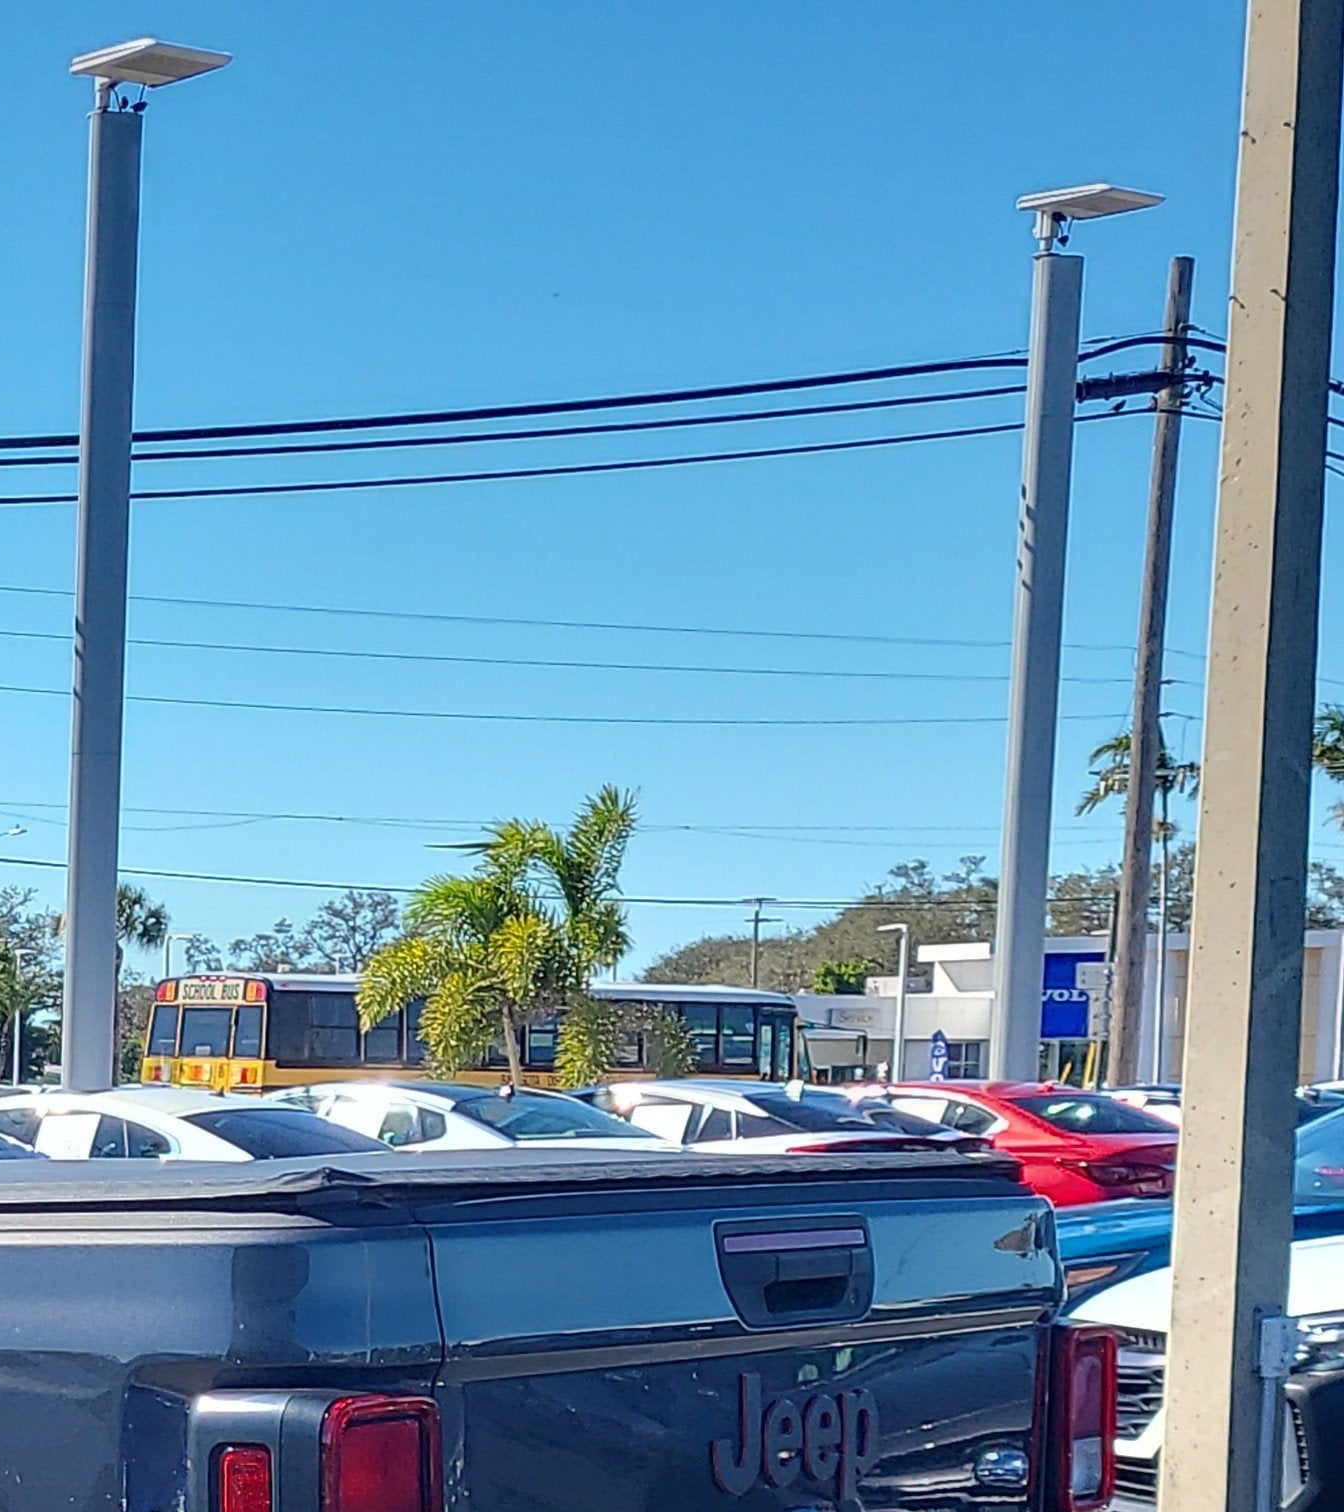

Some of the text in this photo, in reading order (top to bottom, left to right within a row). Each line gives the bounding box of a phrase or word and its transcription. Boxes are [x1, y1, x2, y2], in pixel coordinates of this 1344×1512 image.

[182, 983, 240, 1000] SCHOOL BUS
[709, 1371, 880, 1501] Jeep
